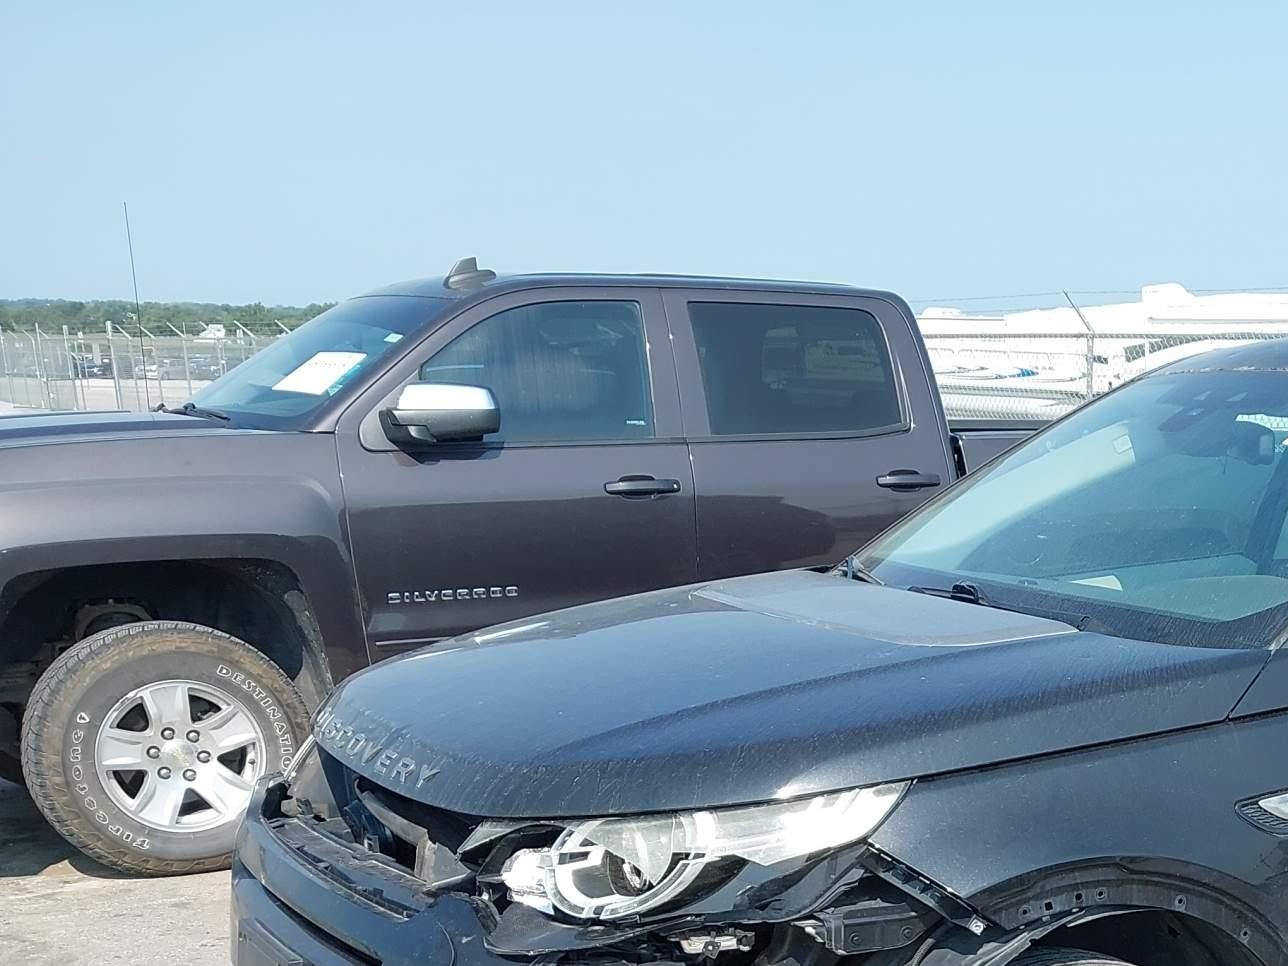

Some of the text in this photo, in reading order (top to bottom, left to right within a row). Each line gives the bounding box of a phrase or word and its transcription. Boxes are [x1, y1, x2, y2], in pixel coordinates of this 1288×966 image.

[387, 585, 518, 604] SILVERADO
[216, 664, 294, 773] DESTINATIO
[316, 707, 441, 789] DISCOVERY
[70, 729, 150, 850] Firestone
